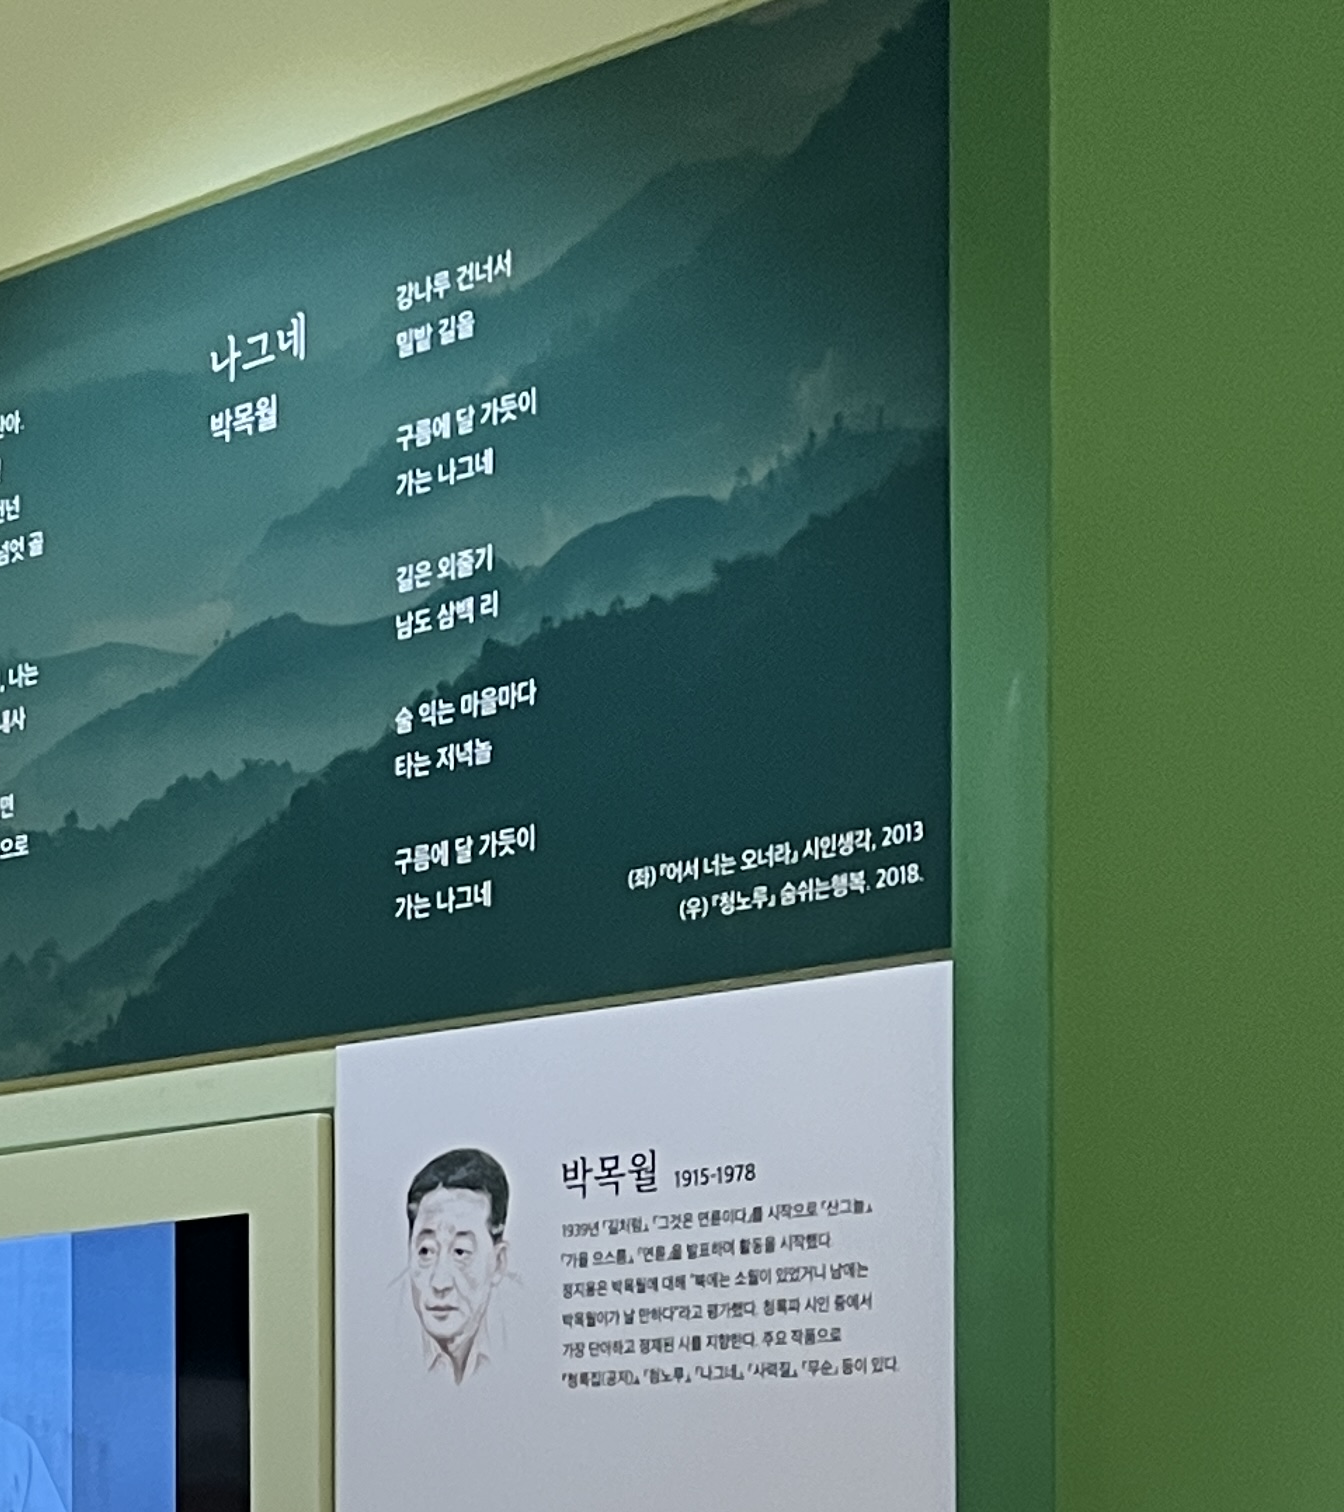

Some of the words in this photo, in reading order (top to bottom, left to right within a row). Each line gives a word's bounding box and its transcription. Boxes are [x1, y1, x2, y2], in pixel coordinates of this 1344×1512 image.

[396, 270, 450, 310] 강나루
[456, 248, 511, 291] 건너서
[210, 311, 304, 382] 나그네
[438, 310, 474, 345] 길을
[210, 393, 276, 442] 박목월
[396, 411, 450, 451] 구름에
[456, 404, 475, 435] 달
[480, 386, 536, 425] 가듯이
[396, 468, 432, 496] 가는
[438, 447, 493, 485] 나그네
[396, 560, 432, 592] 길은
[436, 542, 492, 580] 외줄기
[395, 607, 432, 640] 남도
[436, 596, 473, 630] 삼백
[480, 589, 497, 617] 리
[394, 706, 413, 734] 술
[418, 698, 455, 727] 익는
[460, 677, 536, 718] 마을마다
[395, 750, 431, 779] 타는
[436, 737, 492, 771] 저녁놀
[394, 839, 448, 874] 구름에
[454, 835, 473, 864] 달
[478, 823, 534, 858] 가듯이
[395, 892, 430, 920] 가는
[436, 879, 491, 913] 나그네
[561, 1149, 658, 1198] 박목월
[674, 1162, 755, 1188] 1915-1978
